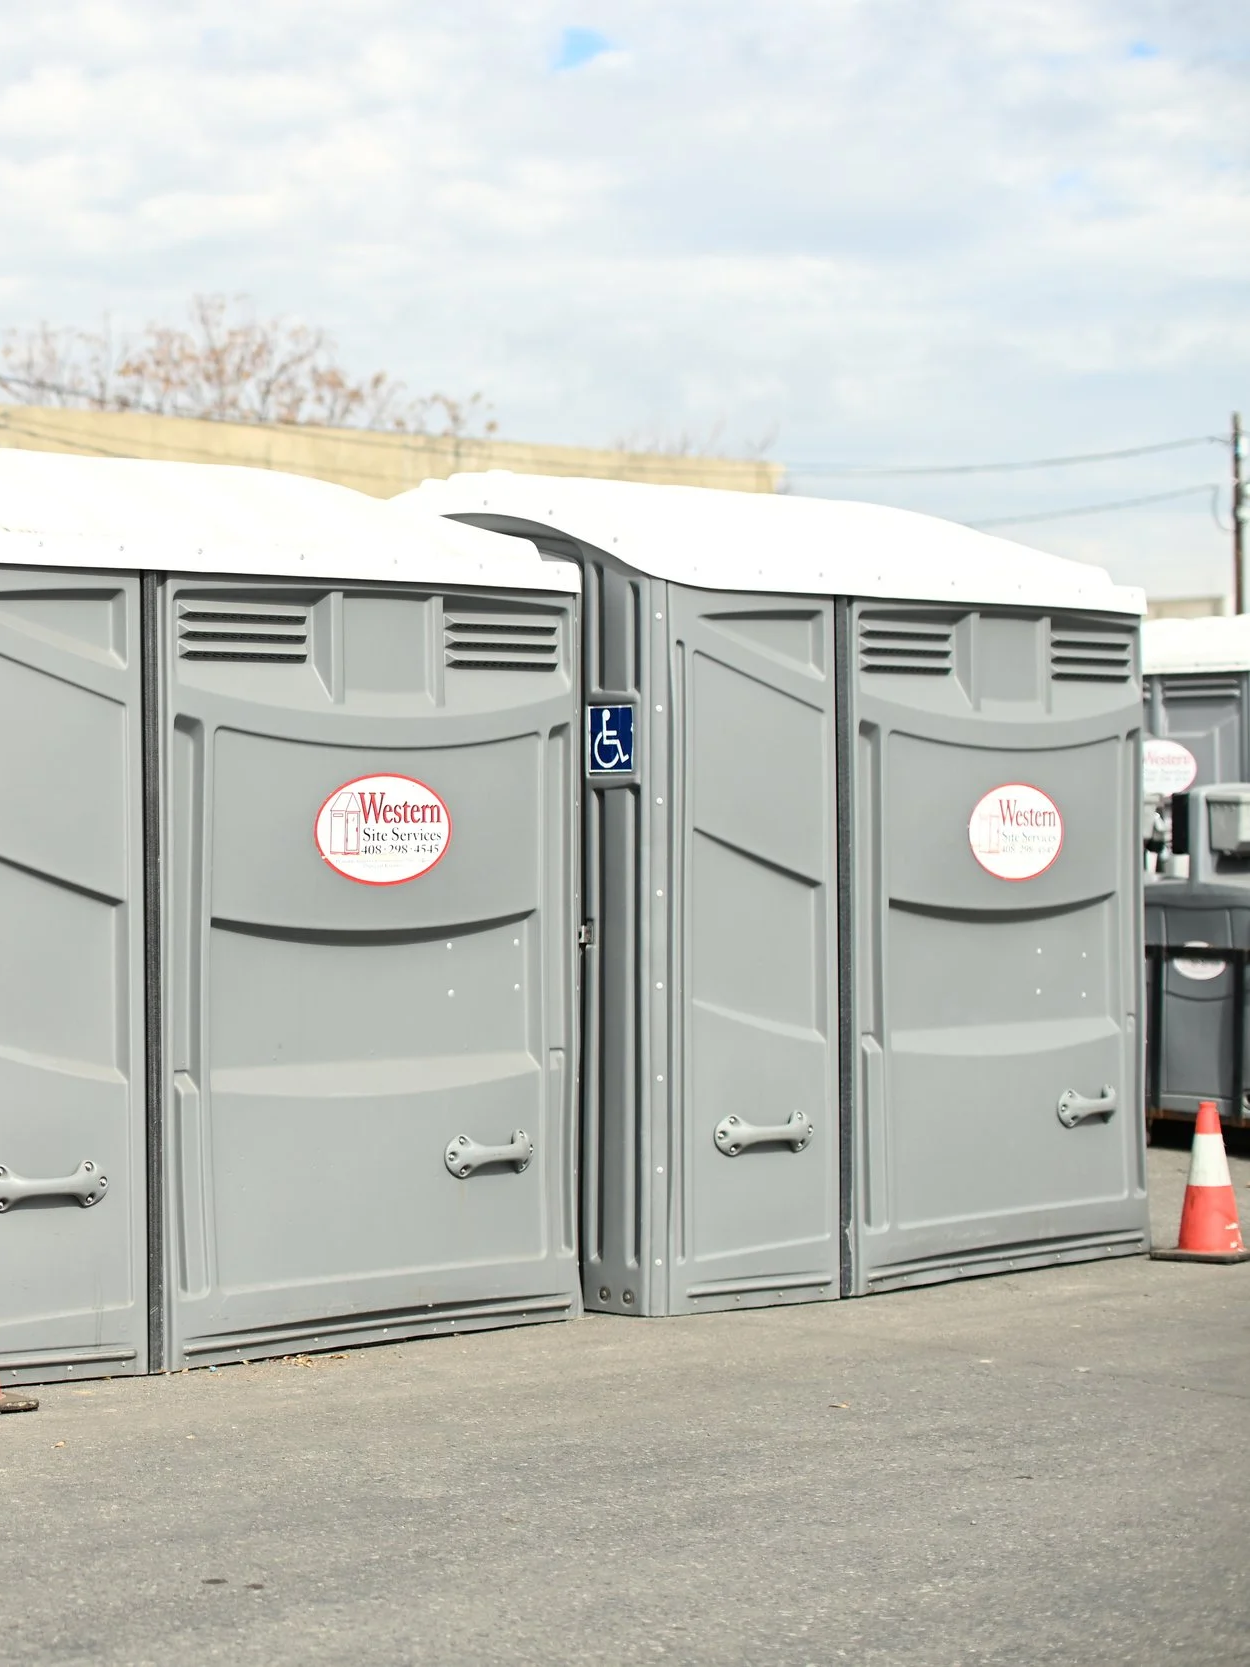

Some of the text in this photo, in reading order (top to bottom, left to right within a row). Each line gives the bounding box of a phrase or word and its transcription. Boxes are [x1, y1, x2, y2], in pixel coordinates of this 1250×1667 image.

[357, 791, 443, 825] Western
[998, 799, 1056, 827] Western
[362, 826, 442, 842] Site Services
